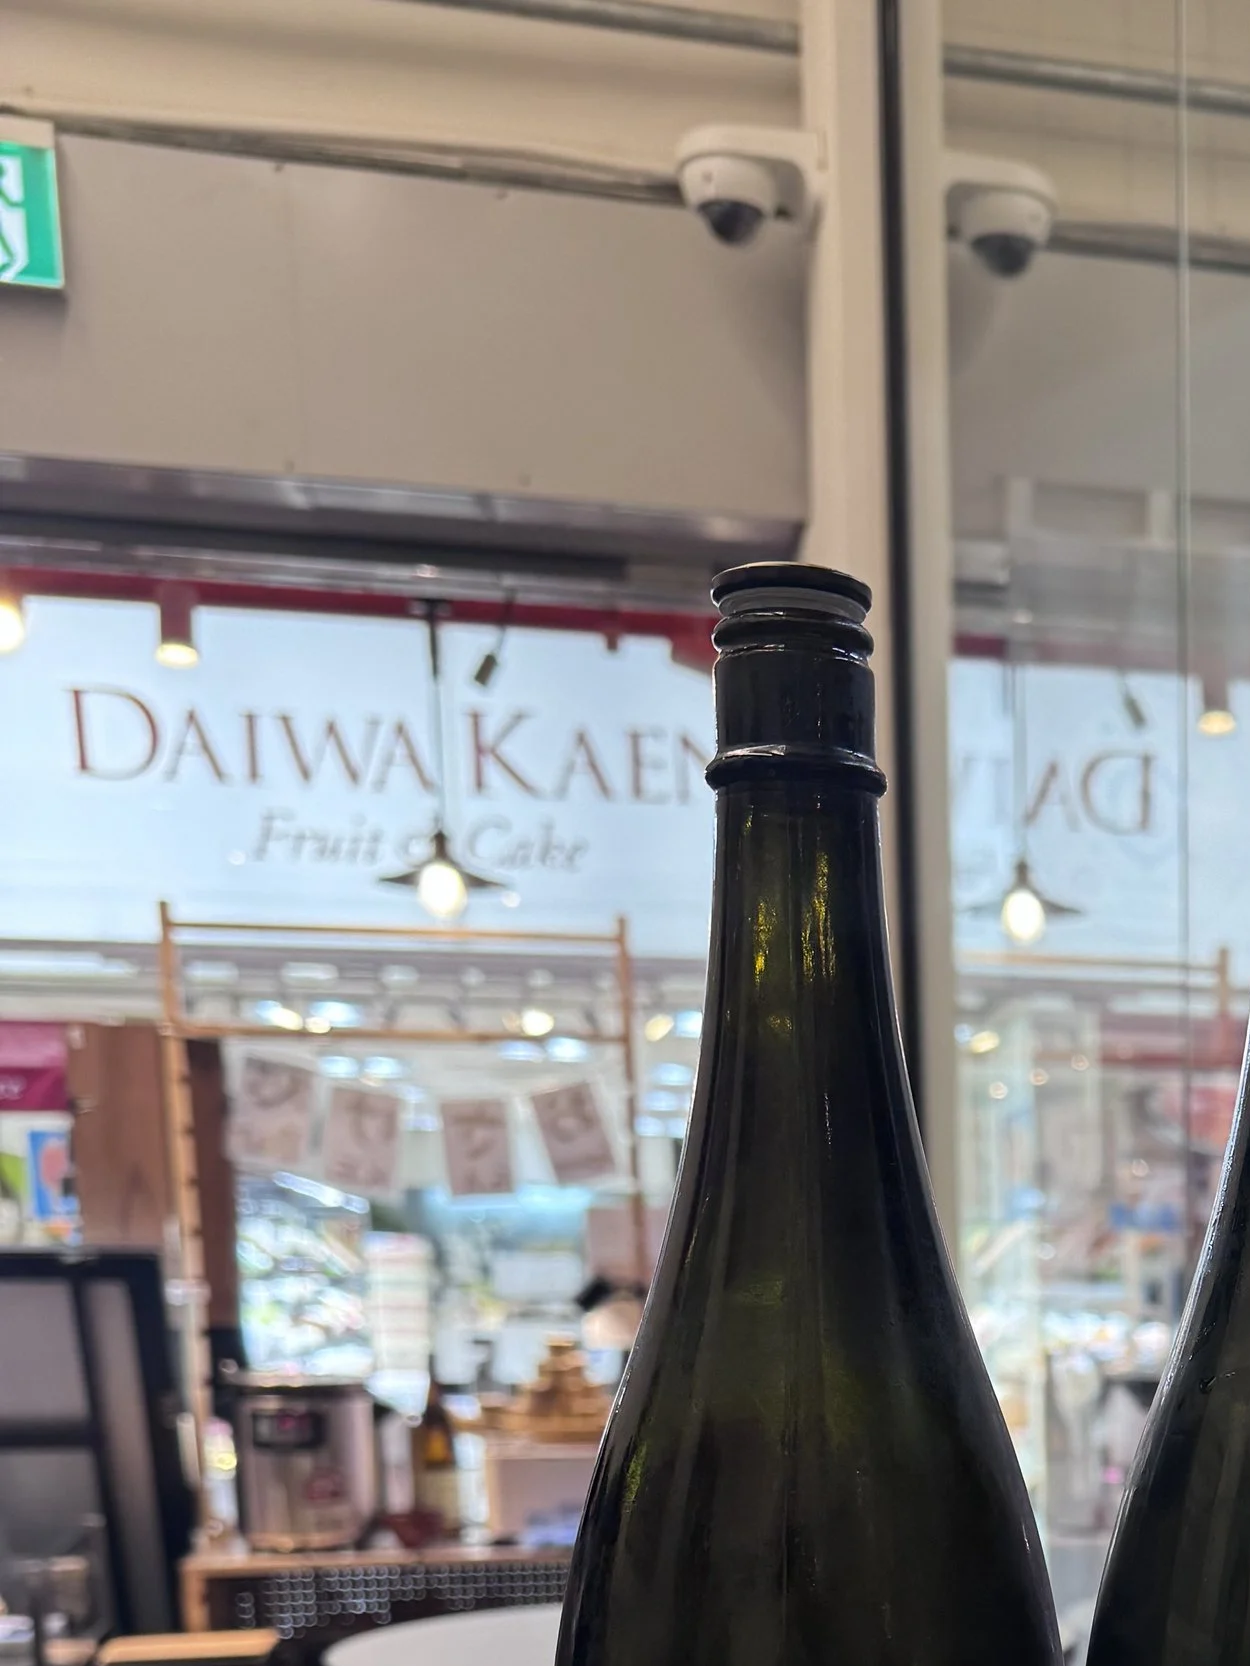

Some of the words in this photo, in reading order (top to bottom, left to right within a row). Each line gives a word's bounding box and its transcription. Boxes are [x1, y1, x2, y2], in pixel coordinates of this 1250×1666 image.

[66, 685, 438, 794] DAIWA
[252, 806, 384, 866] Fruit
[466, 812, 590, 873] Cake
